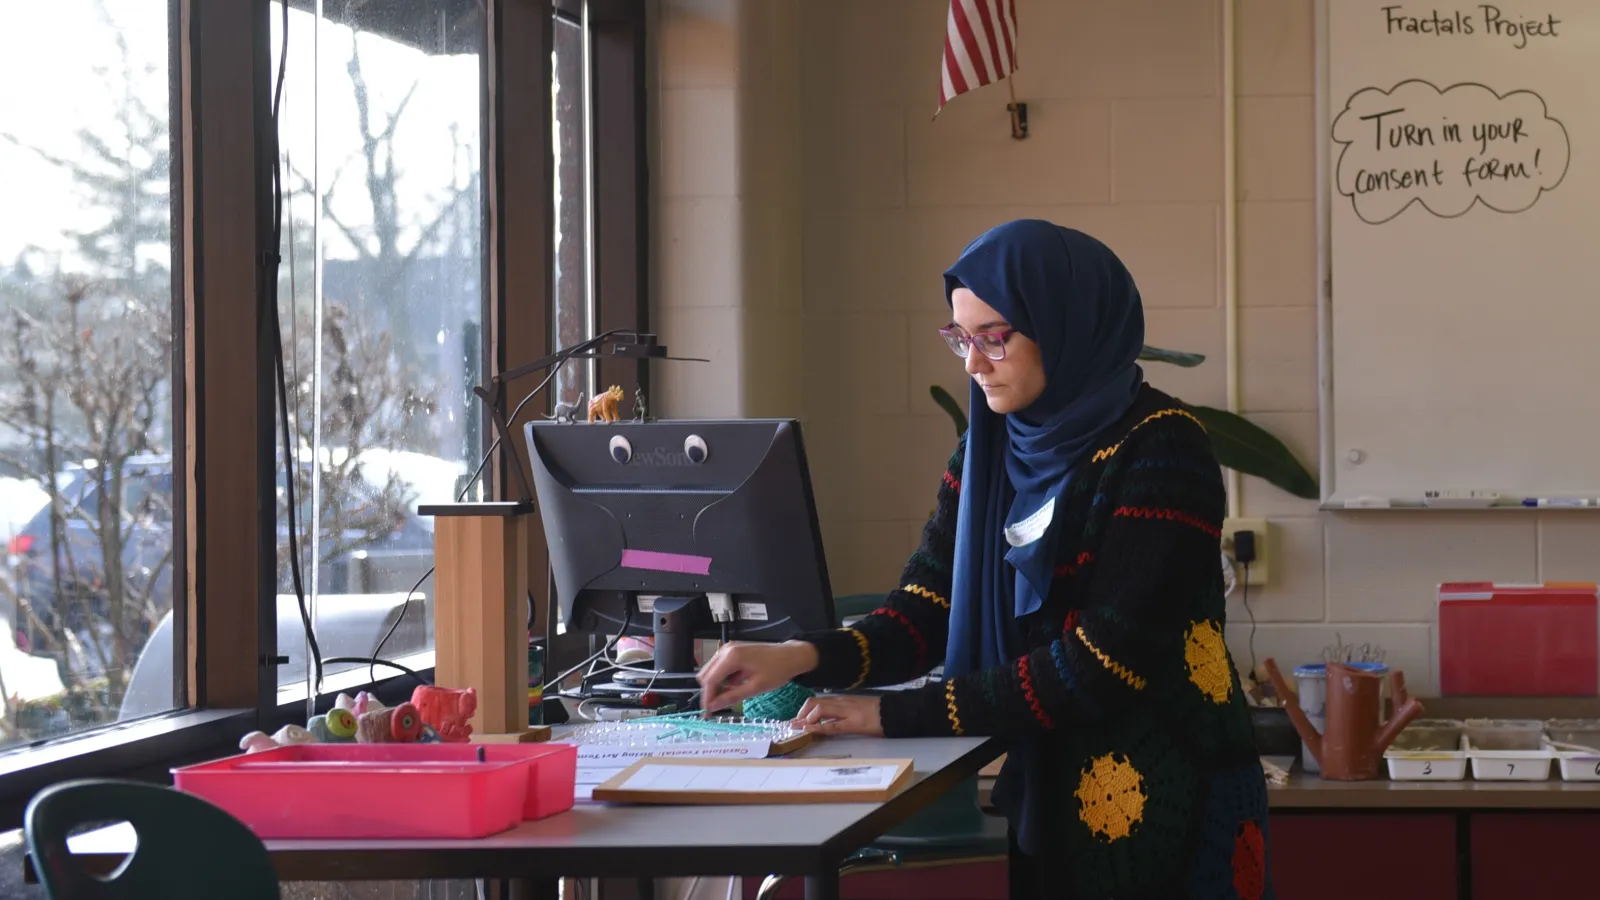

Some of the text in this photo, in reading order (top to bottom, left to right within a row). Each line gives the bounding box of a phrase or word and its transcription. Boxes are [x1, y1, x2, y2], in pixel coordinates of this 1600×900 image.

[1381, 4, 1562, 50] Fractals Project
[1359, 107, 1528, 156] Turn in your
[1355, 159, 1443, 194] consent
[1422, 761, 1433, 775] 3
[1506, 763, 1515, 776] 7
